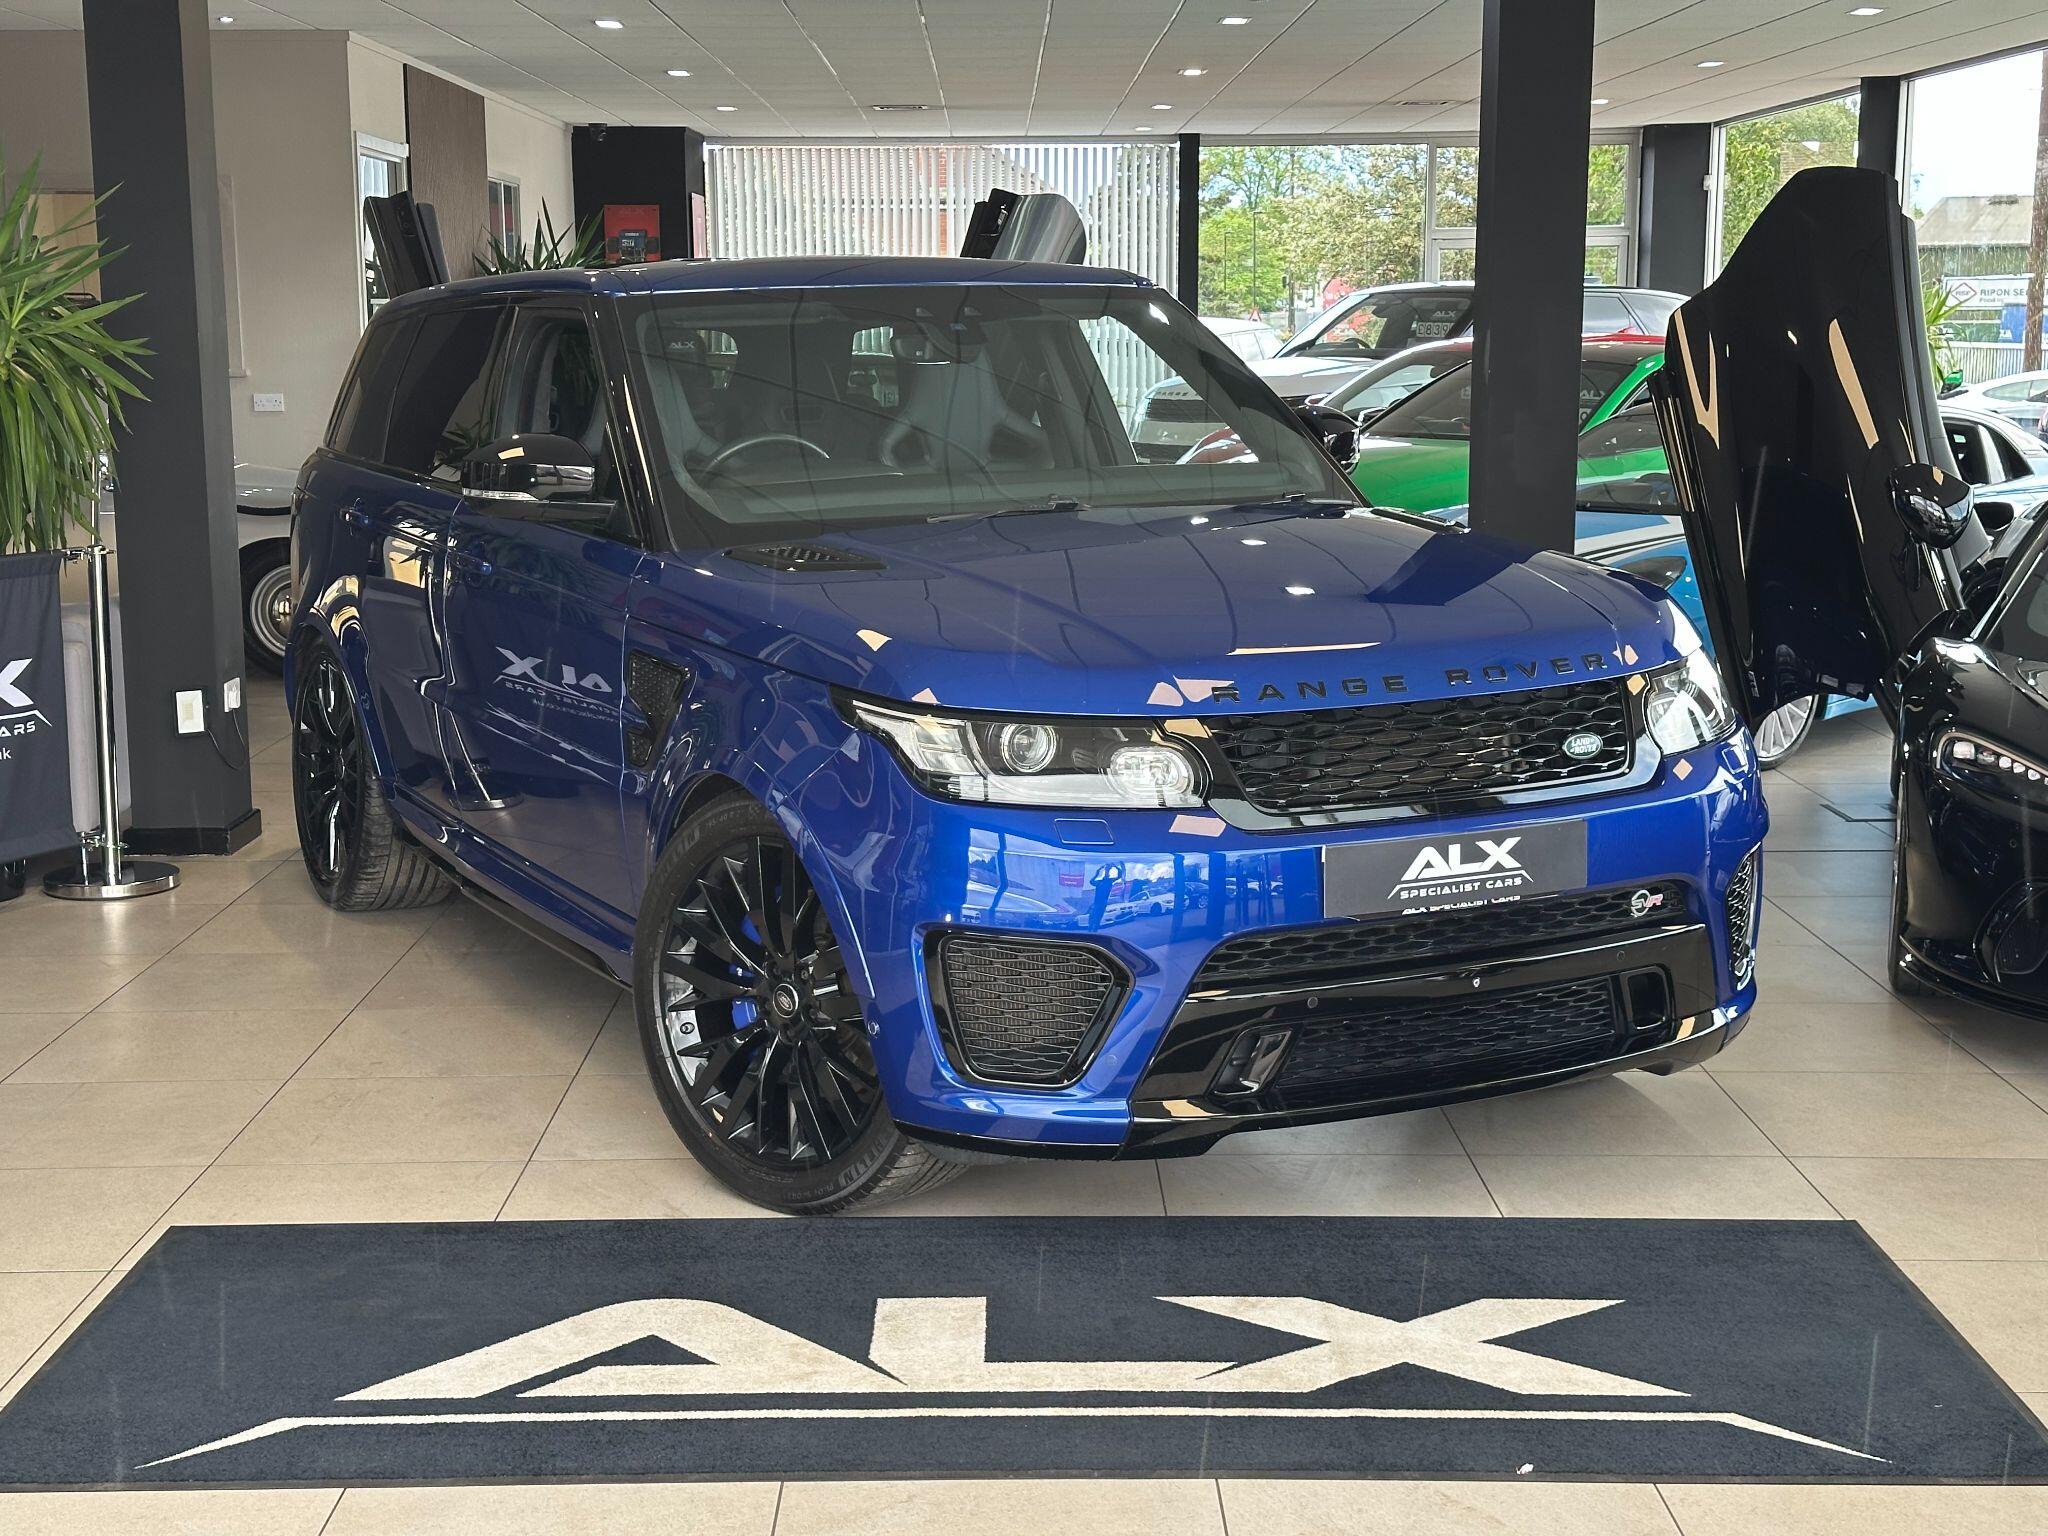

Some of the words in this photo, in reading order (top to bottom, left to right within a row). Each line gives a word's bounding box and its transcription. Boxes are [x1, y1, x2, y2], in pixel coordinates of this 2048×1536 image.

[1980, 288, 2010, 297] RIPON
[2013, 288, 2027, 297] SE
[1418, 322, 1453, 336] £839
[669, 340, 695, 349] ALX
[1211, 675, 1408, 704] RANGE
[1445, 653, 1608, 686] ROVER
[1571, 737, 1590, 747] LAND
[1574, 744, 1597, 754] ROVER
[1401, 837, 1522, 881] ALX
[1400, 882, 1481, 899] SPECIALIST
[1486, 877, 1523, 888] CARS
[334, 1296, 1692, 1401] ALX
